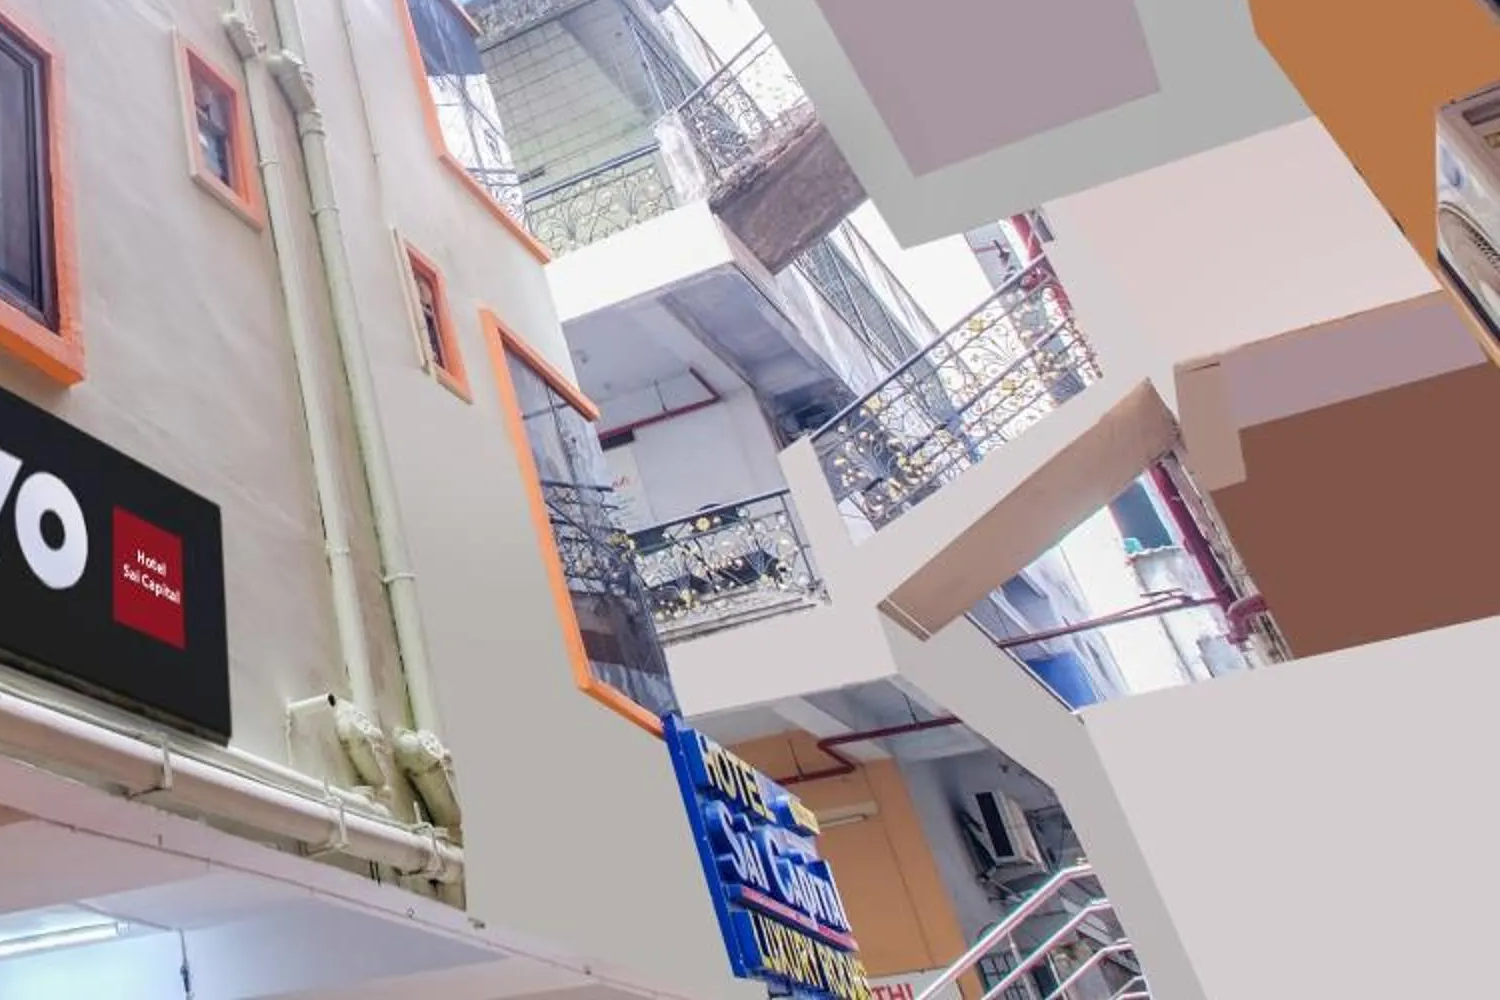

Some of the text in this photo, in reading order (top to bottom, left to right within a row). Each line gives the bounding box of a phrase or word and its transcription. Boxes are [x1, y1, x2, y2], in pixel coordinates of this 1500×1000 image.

[123, 563, 181, 604] Sai Capital
[137, 549, 167, 577] Hotel
[695, 729, 777, 824] HOTEL
[749, 910, 823, 988] LUXURY
